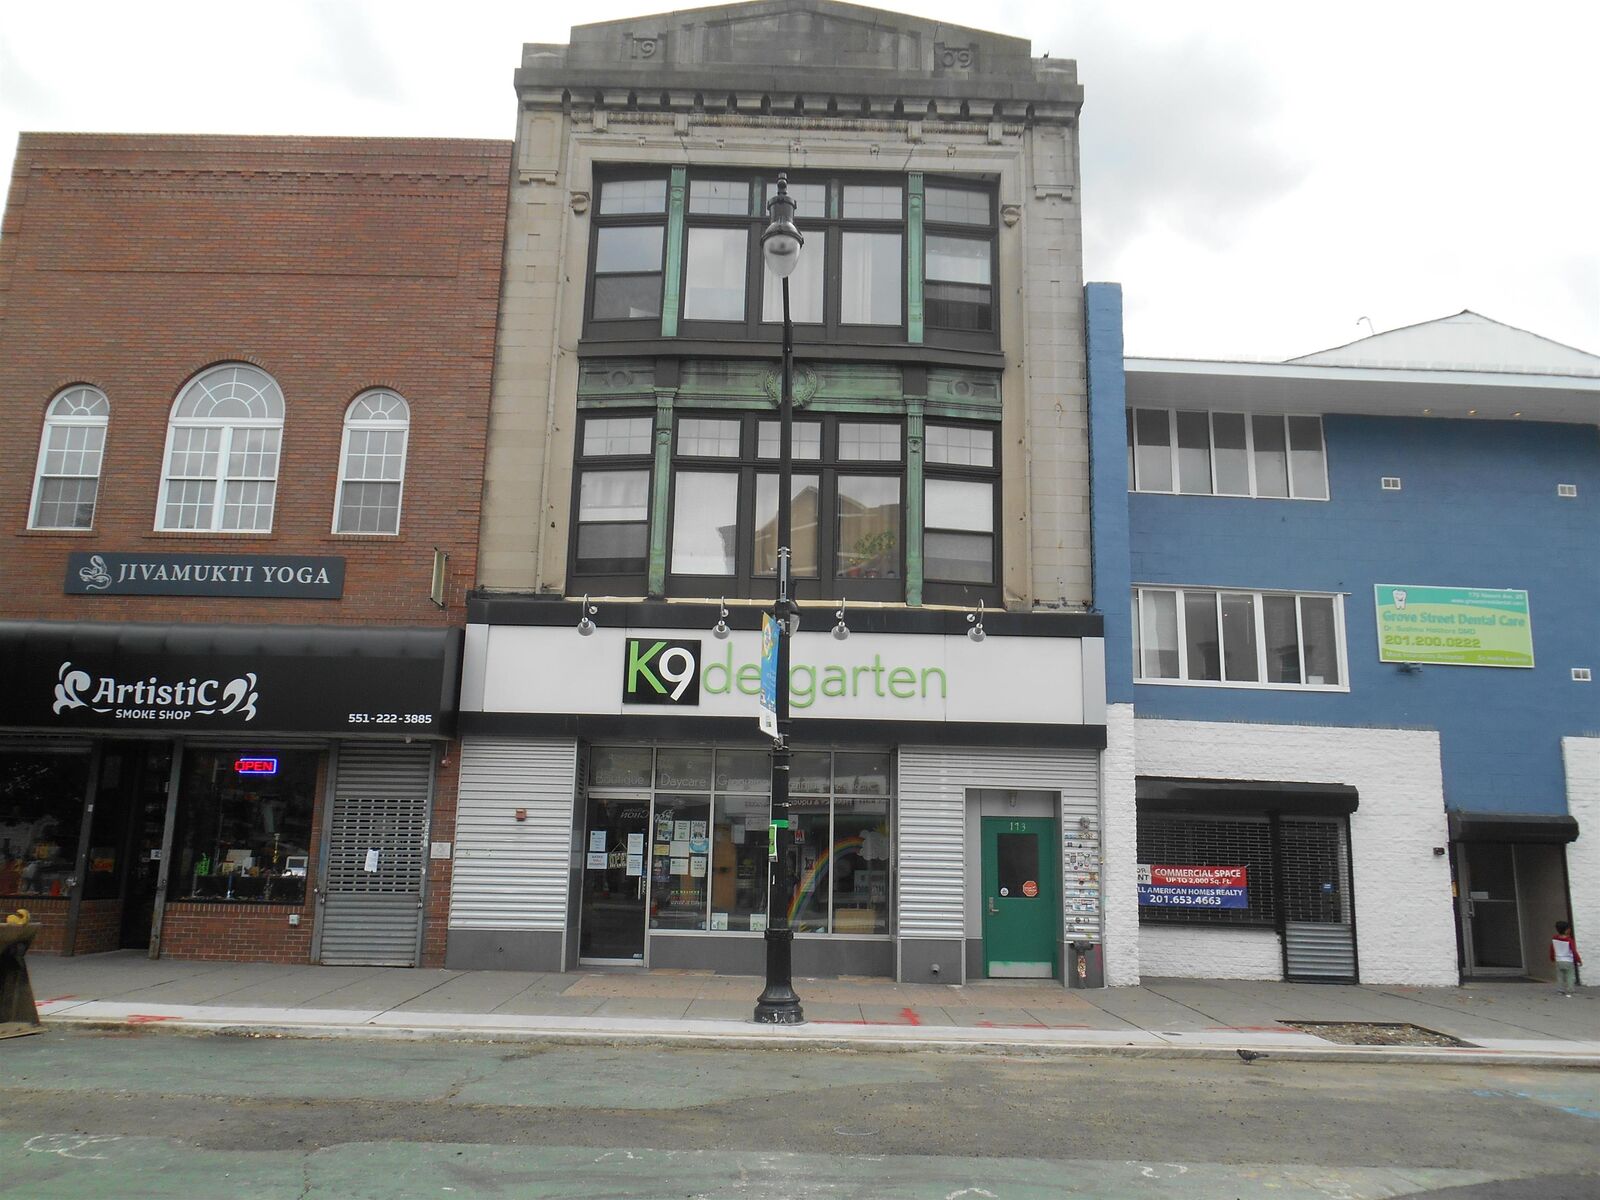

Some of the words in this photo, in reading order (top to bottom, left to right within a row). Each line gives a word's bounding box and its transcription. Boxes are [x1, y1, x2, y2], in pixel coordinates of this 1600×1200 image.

[633, 40, 656, 57] 19
[117, 563, 254, 583] JIVAMUKTI
[262, 566, 331, 585] YOGA
[1383, 611, 1417, 623] Grove
[1420, 612, 1455, 624] Street
[1459, 614, 1496, 626] Dental
[1500, 615, 1525, 627] Care
[1384, 635, 1481, 648] 201.200.0222
[703, 641, 947, 709] degarten
[92, 677, 219, 706] ArtistiC
[115, 709, 156, 719] SMOKE
[159, 710, 191, 720] SHOP
[348, 713, 432, 724] 551-222-3885
[235, 760, 273, 771] OPEN
[661, 773, 706, 788] Daycare
[1155, 868, 1213, 877] COMMERCIAL
[1215, 869, 1241, 878] SPACE
[1147, 887, 1187, 895] AMERICAN
[1189, 888, 1215, 896] HOMES
[1216, 889, 1243, 897] REALTY
[1150, 895, 1221, 905] 201.653.4663
